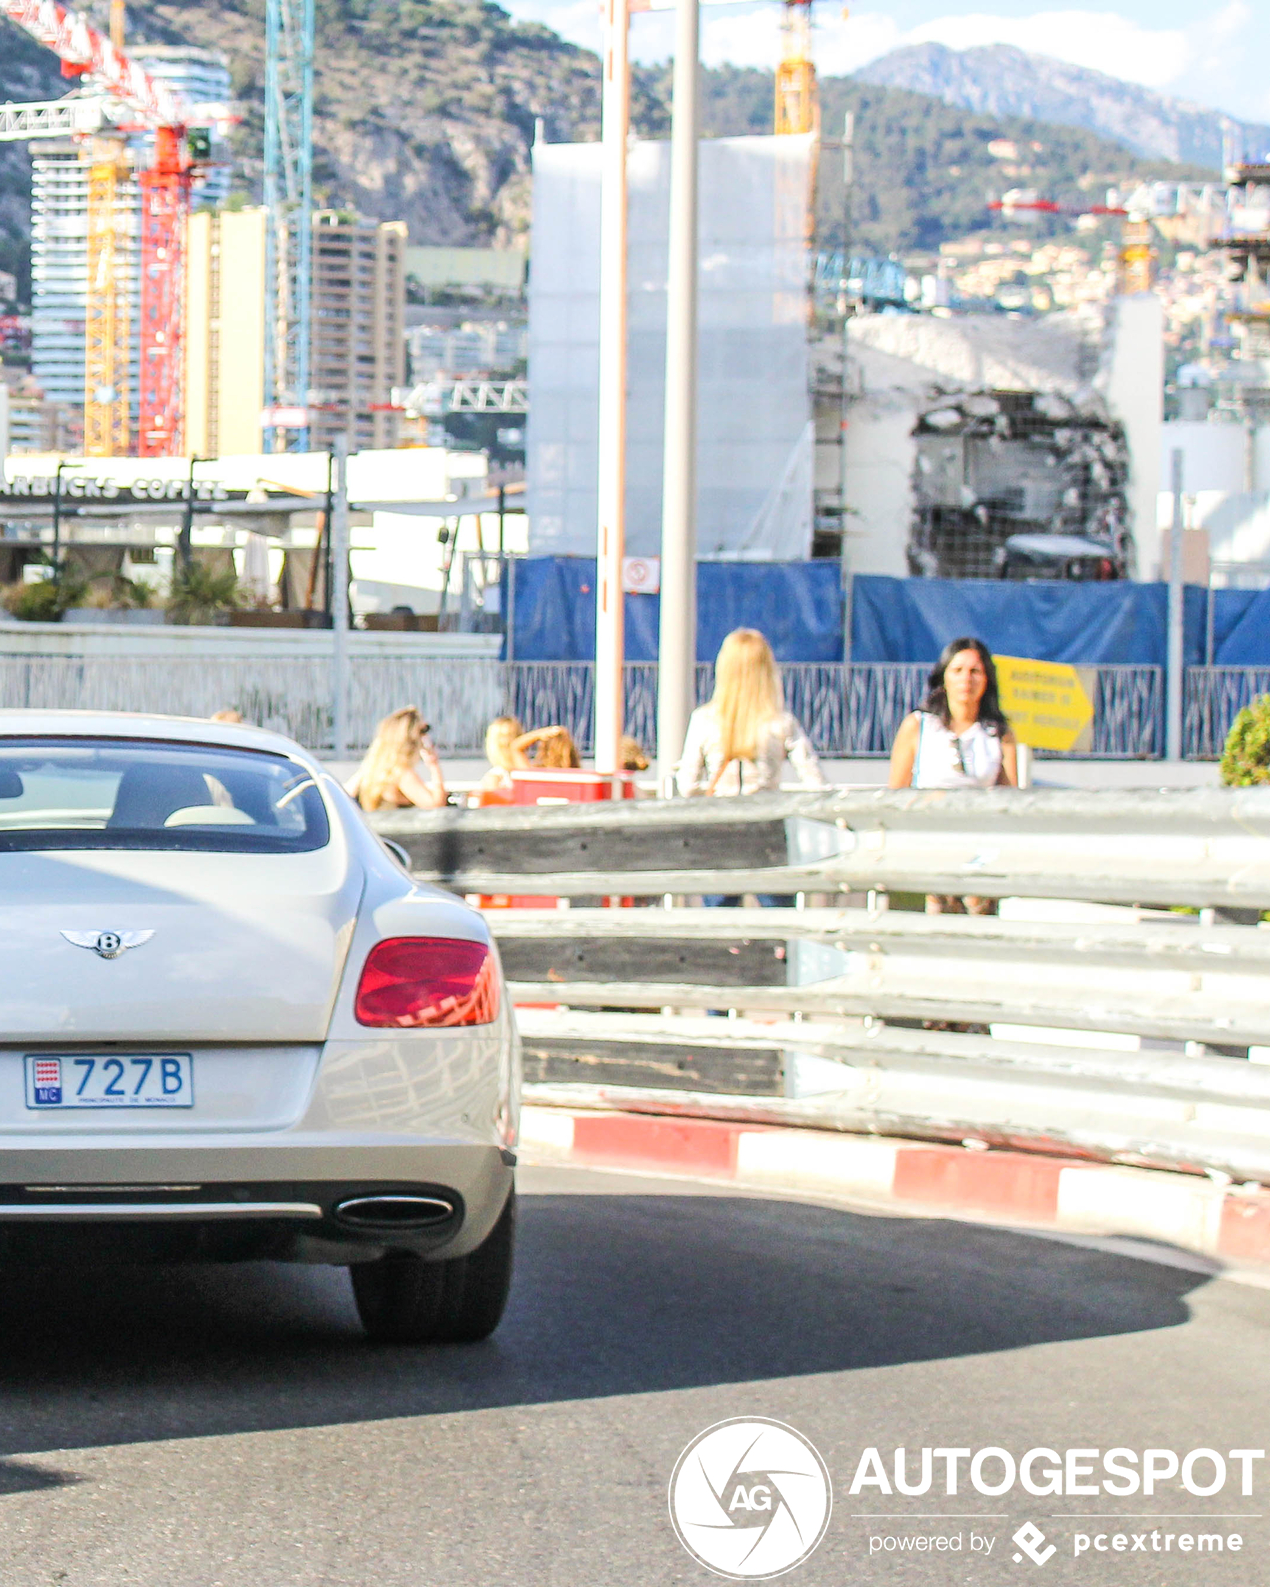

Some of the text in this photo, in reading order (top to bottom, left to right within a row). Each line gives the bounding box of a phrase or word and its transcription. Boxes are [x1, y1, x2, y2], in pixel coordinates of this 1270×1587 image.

[131, 478, 229, 500] COFFEE
[74, 1058, 183, 1096] 727B
[39, 1088, 58, 1102] MC
